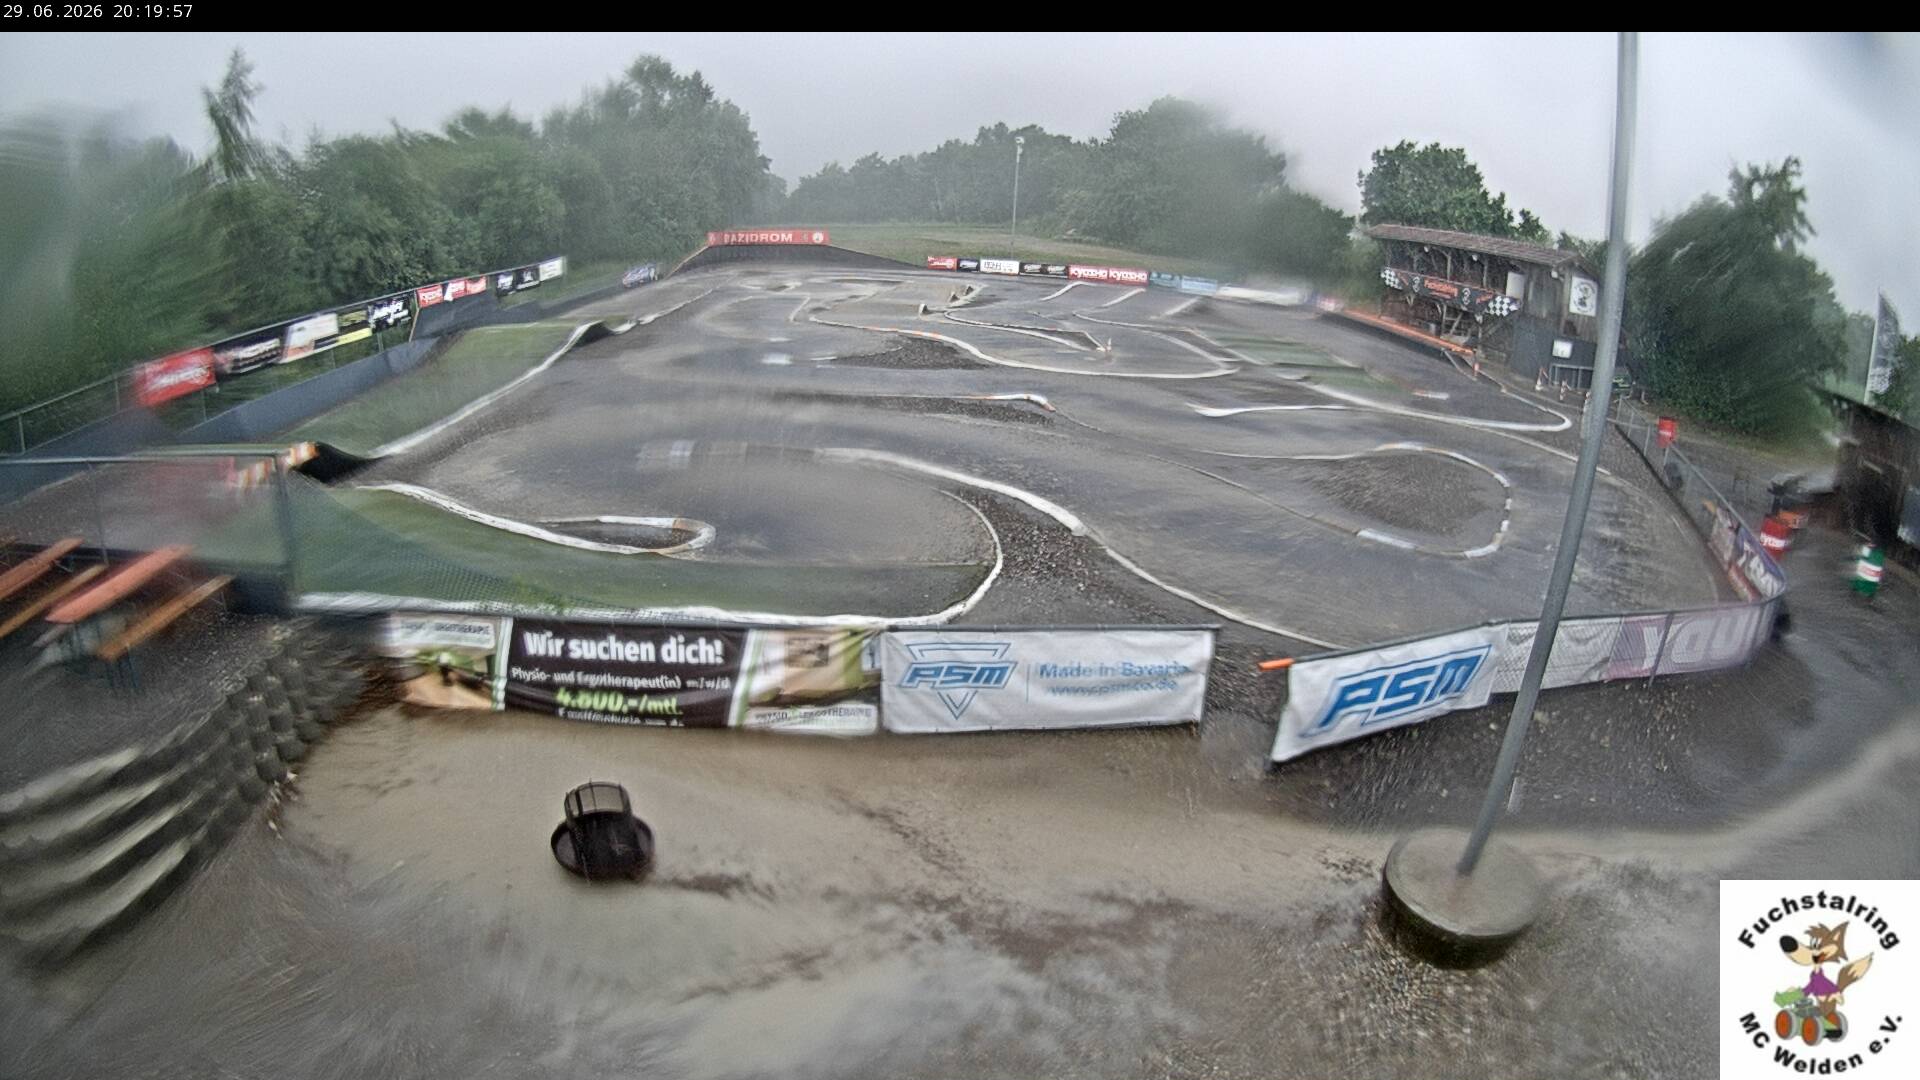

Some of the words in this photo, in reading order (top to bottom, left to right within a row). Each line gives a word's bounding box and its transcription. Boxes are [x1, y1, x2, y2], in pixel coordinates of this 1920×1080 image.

[523, 630, 565, 657] Wir
[568, 635, 656, 662] suchen
[661, 634, 725, 664] dich!
[511, 666, 551, 682] Physio-
[553, 670, 576, 683] und
[904, 664, 1011, 687] PSM
[1039, 661, 1093, 679] Made
[1099, 661, 1116, 677] in
[1317, 653, 1485, 728] PSM
